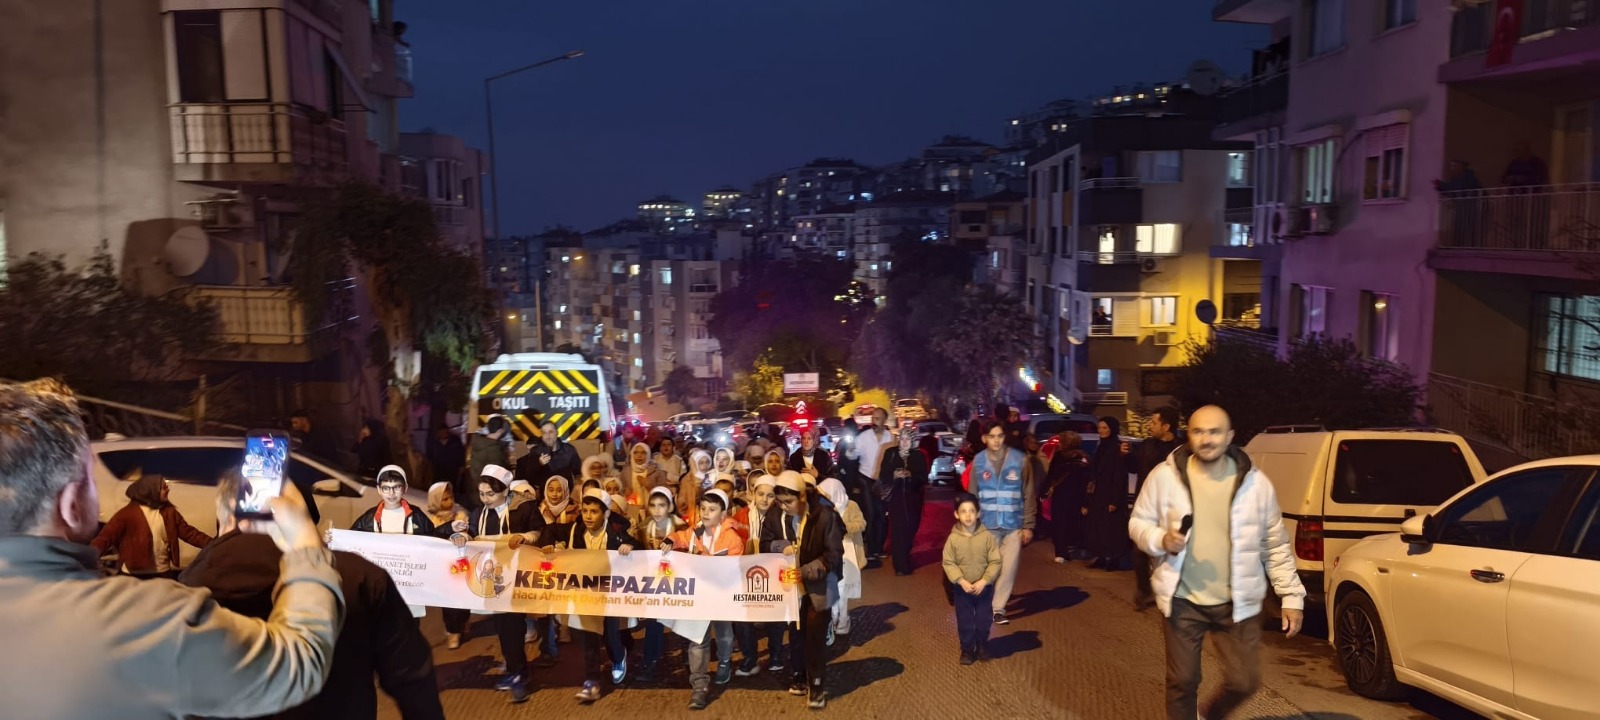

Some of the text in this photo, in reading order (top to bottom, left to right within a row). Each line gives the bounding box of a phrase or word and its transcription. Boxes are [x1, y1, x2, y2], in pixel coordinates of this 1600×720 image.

[492, 396, 591, 411] OKUL TAŞITI
[514, 569, 696, 596] KESTANEPAZARI
[512, 590, 537, 601] Hacı
[624, 596, 660, 606] Kur'an
[662, 597, 694, 607] Kursu
[733, 594, 783, 602] KESTANEPAZARI
